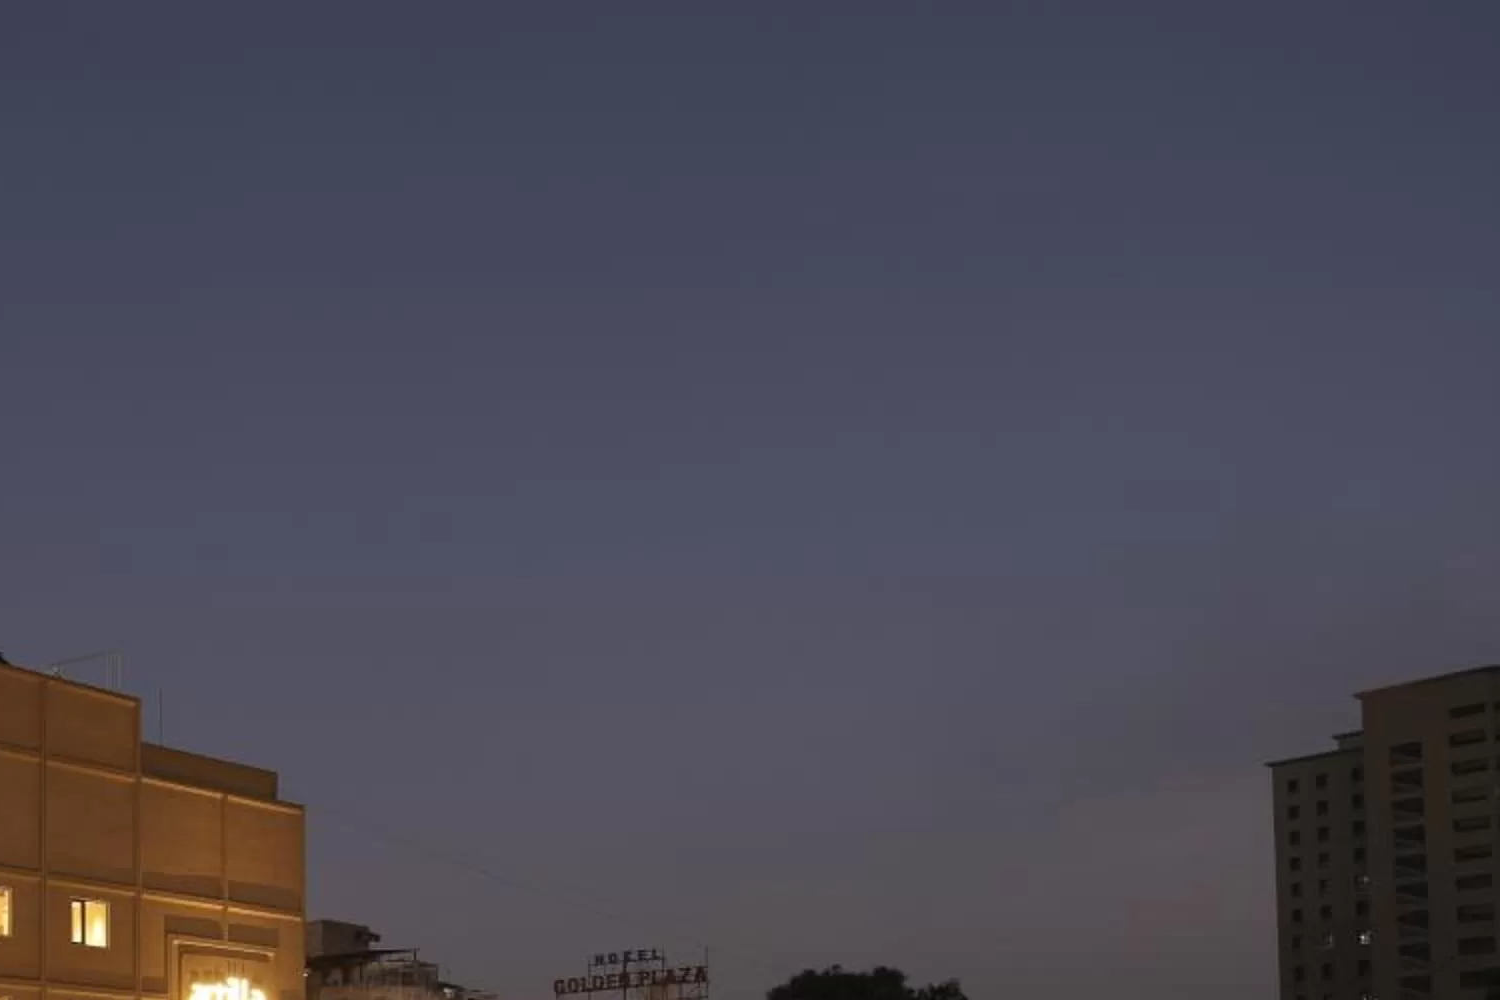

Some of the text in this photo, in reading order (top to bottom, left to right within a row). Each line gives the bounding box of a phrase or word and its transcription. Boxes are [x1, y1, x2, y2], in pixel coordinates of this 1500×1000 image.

[595, 948, 660, 965] HOTEL
[554, 966, 707, 994] GOLDEN PLAZA
